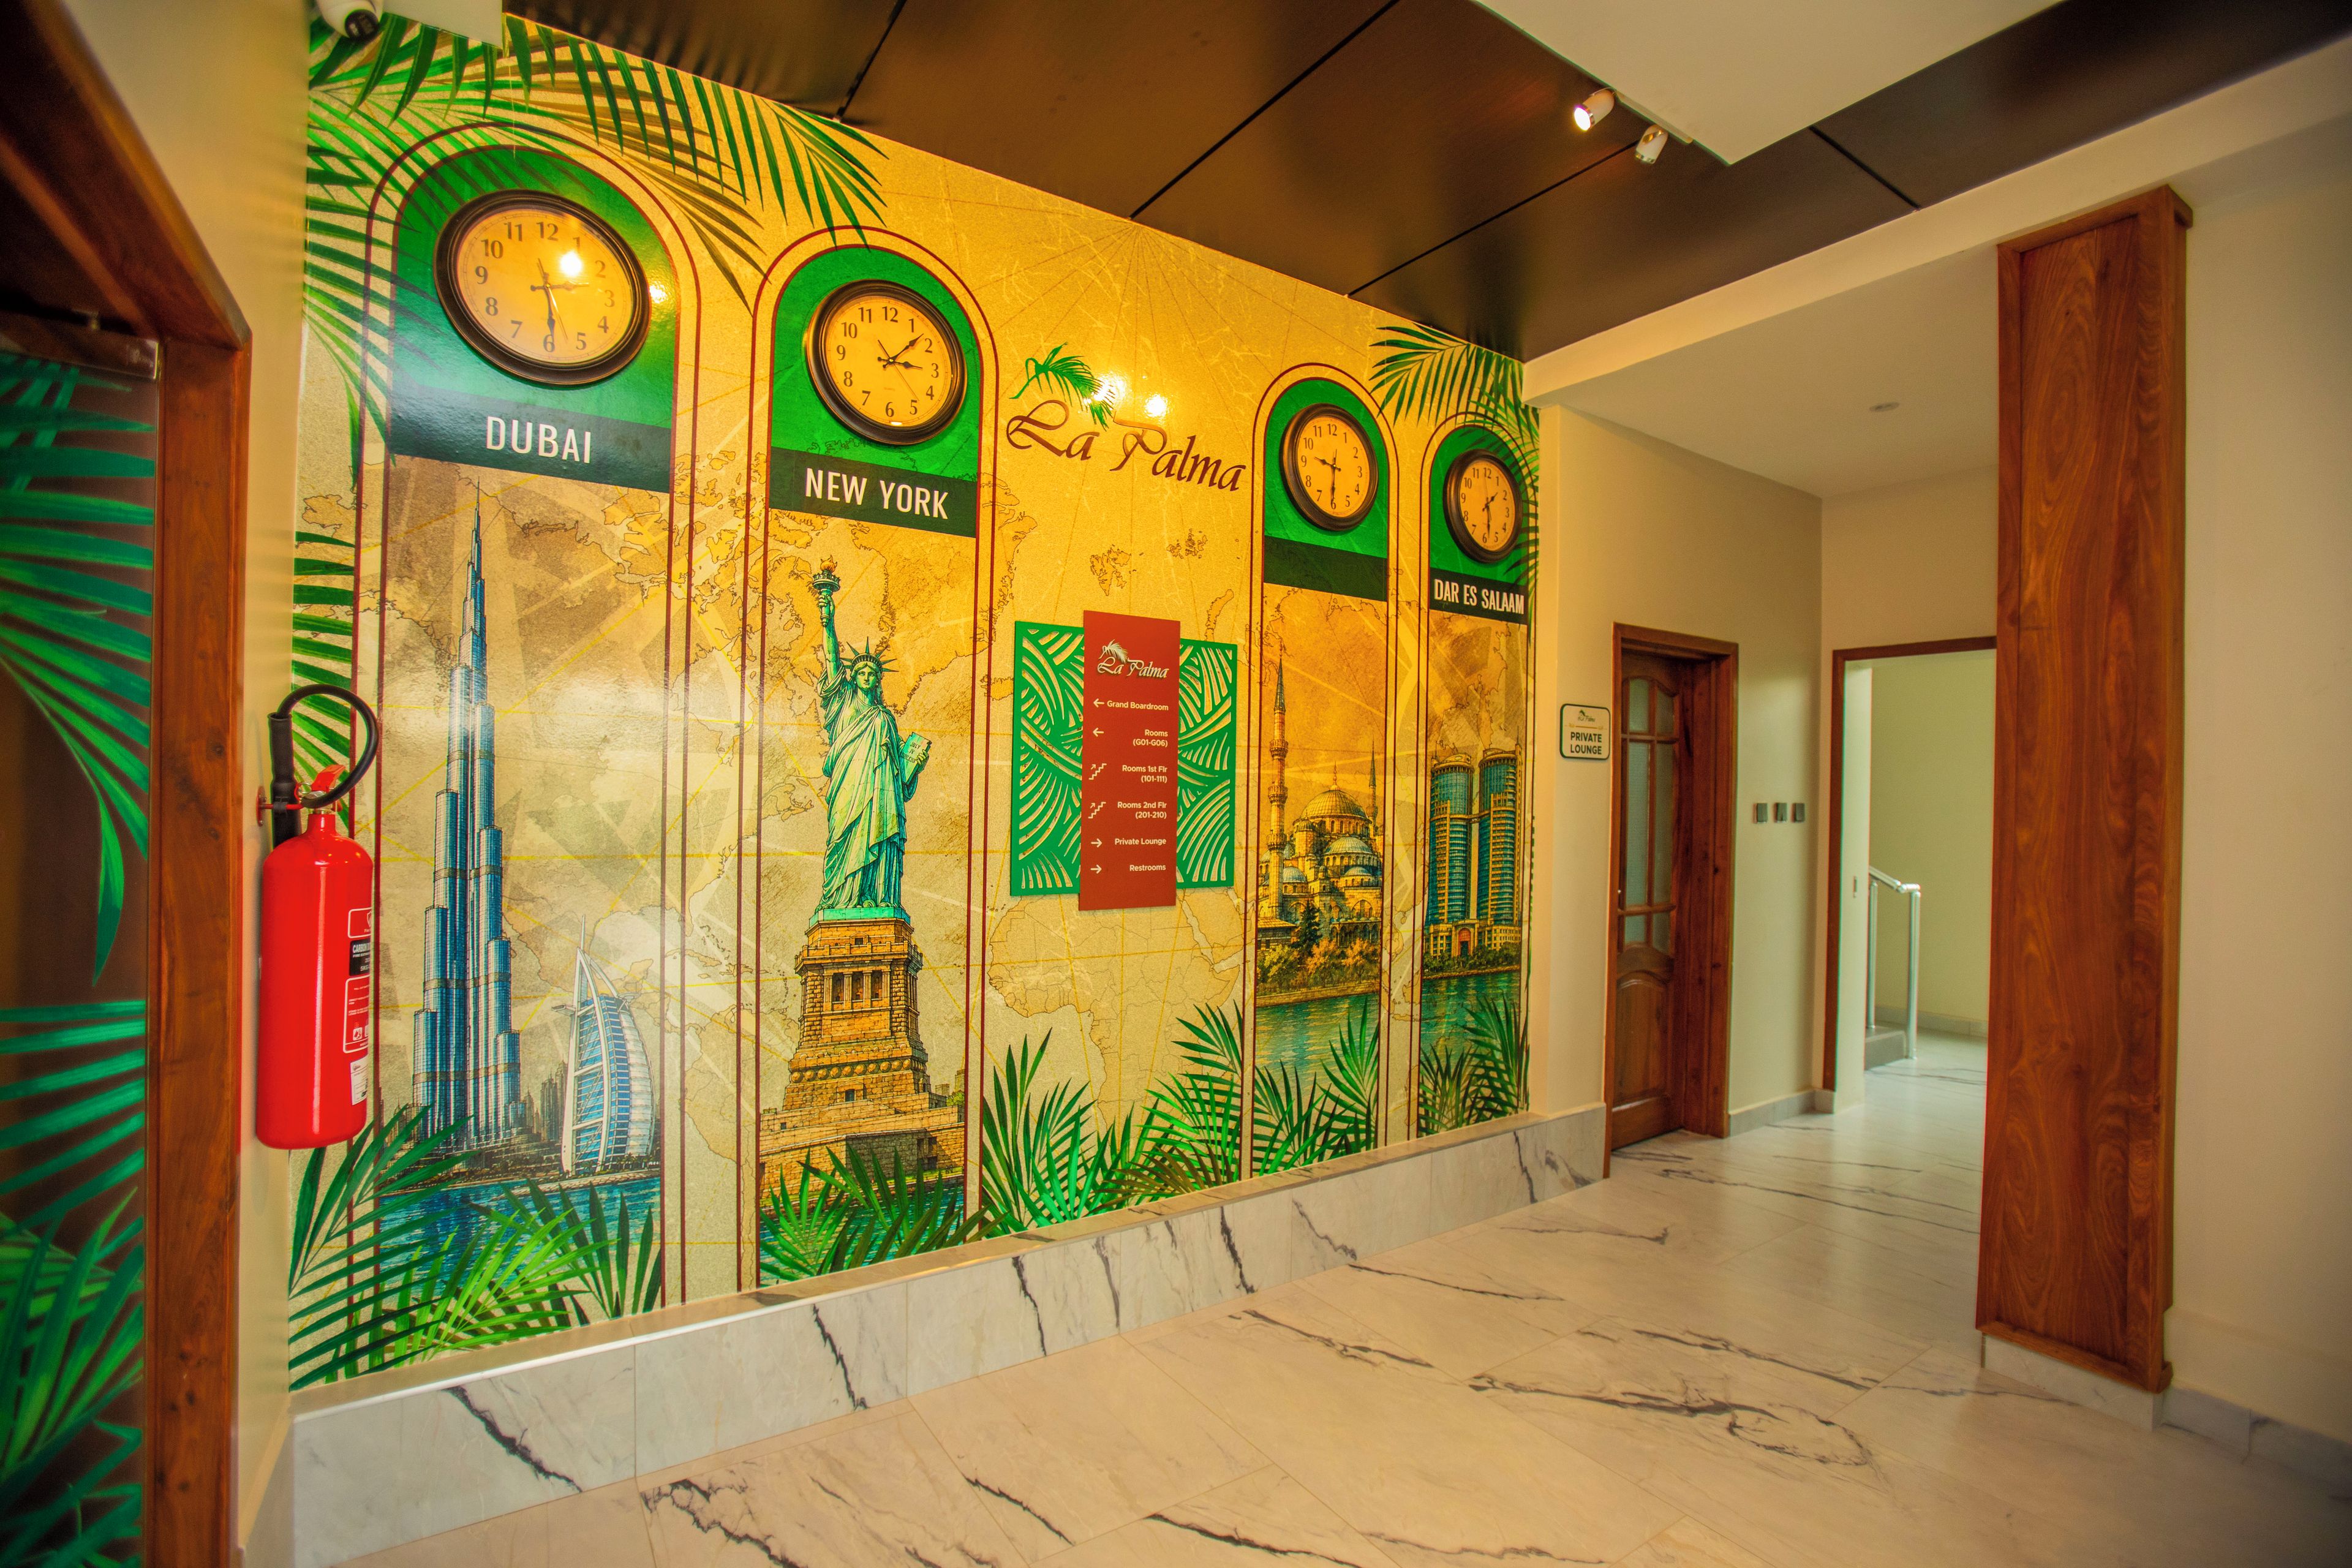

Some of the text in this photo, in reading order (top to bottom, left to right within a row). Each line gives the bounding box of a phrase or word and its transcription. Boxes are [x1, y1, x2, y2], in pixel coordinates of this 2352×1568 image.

[503, 222, 522, 241] 11
[536, 222, 559, 241] 12
[481, 239, 503, 258] 10
[573, 236, 581, 252] 1
[475, 266, 488, 284] 9
[595, 260, 606, 277] 2
[485, 297, 499, 315] 8
[604, 290, 615, 307] 3
[858, 307, 872, 323] 11
[882, 306, 898, 323] 12
[511, 320, 522, 338] 7
[597, 316, 609, 333] 4
[842, 322, 858, 338] 10
[908, 318, 914, 333] 1
[543, 334, 555, 352] 6
[576, 332, 586, 350] 5
[925, 338, 932, 353] 2
[837, 345, 846, 360] 9
[931, 363, 939, 378] 3
[843, 371, 853, 386] 8
[862, 390, 871, 405] 7
[926, 385, 935, 400] 4
[886, 402, 894, 417] 6
[910, 399, 918, 415] 5
[1313, 425, 1322, 437] 11
[1327, 424, 1337, 436] 12
[1343, 432, 1347, 443] 1
[486, 416, 591, 464] DUBAI
[1006, 399, 1246, 491] La Palma
[1303, 437, 1313, 450] 10
[1353, 447, 1358, 459] 2
[1301, 455, 1307, 467] 9
[1357, 466, 1362, 478] 3
[1472, 468, 1479, 478] 11
[1483, 467, 1491, 479] 12
[1305, 475, 1311, 488] 8
[1355, 483, 1360, 495] 4
[1464, 478, 1472, 489] 10
[805, 467, 949, 519] NEW YORK
[1317, 489, 1322, 502] 7
[1461, 493, 1466, 503] 9
[1503, 490, 1507, 500] 2
[1331, 497, 1336, 510] 6
[1345, 495, 1350, 507] 5
[1464, 510, 1468, 521] 8
[1506, 507, 1509, 518] 3
[1472, 524, 1476, 535] 7
[1502, 522, 1506, 532] 4
[1483, 532, 1487, 543] 6
[1494, 532, 1498, 543] 5
[1434, 579, 1525, 614] DAR ES SALAAM
[1097, 656, 1169, 678] La Palma
[1107, 700, 1169, 710] Grand Boardroom
[1133, 738, 1168, 747] (G01-G06)
[1570, 731, 1602, 742] PRIVATE
[1570, 744, 1602, 755] LOUNGE
[1141, 775, 1167, 783] (101-111)
